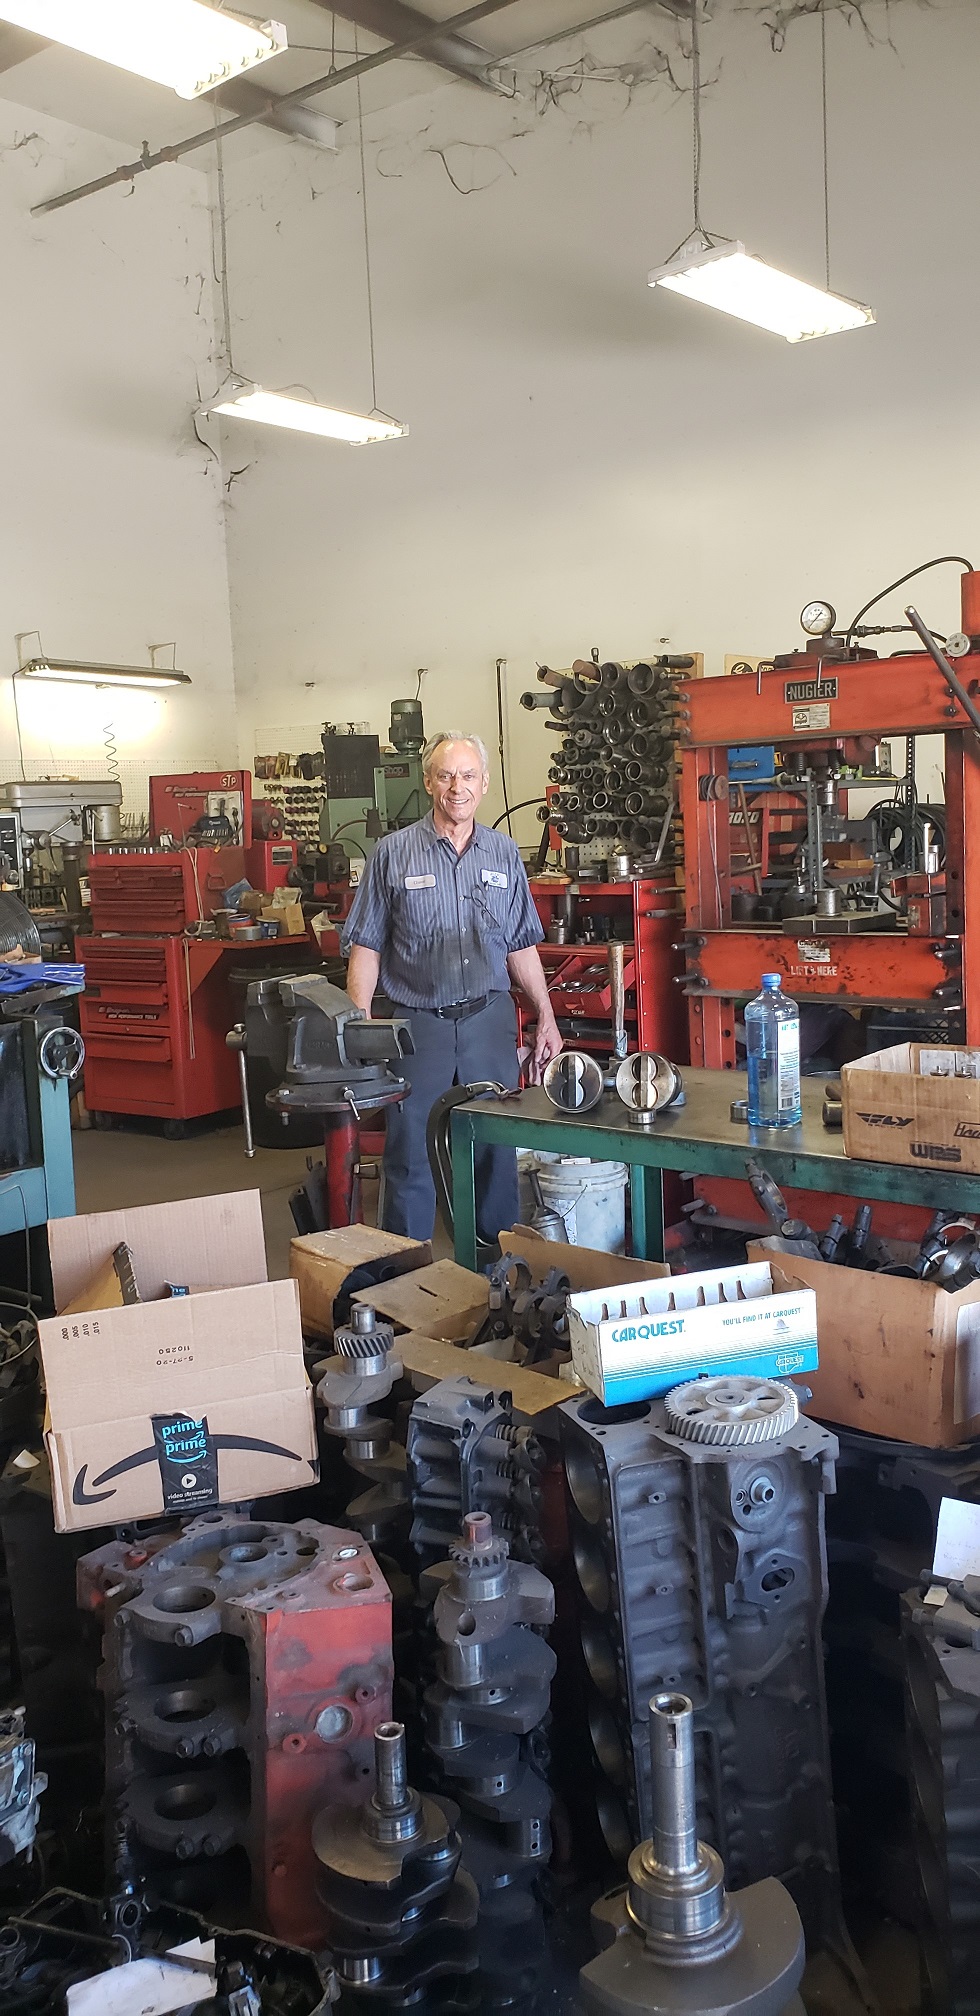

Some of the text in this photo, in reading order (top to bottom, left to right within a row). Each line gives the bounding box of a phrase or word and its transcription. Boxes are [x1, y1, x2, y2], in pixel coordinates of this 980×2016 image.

[789, 682, 833, 700] NUGIER
[222, 774, 237, 787] STP
[790, 965, 838, 976] LIFT HERE
[863, 1112, 916, 1127] FLY
[722, 1317, 741, 1326] YOU'LL
[742, 1314, 757, 1323] FIND
[772, 1307, 802, 1318] CARQUEST
[61, 1327, 69, 1340] .000
[71, 1325, 80, 1338] .005
[82, 1323, 90, 1336] .010
[92, 1321, 101, 1334] .015
[611, 1319, 685, 1343] CARQUEST
[162, 1420, 203, 1439] prime
[165, 1438, 207, 1456] prime
[167, 1492, 183, 1500] video
[184, 1488, 213, 1498] streaming
